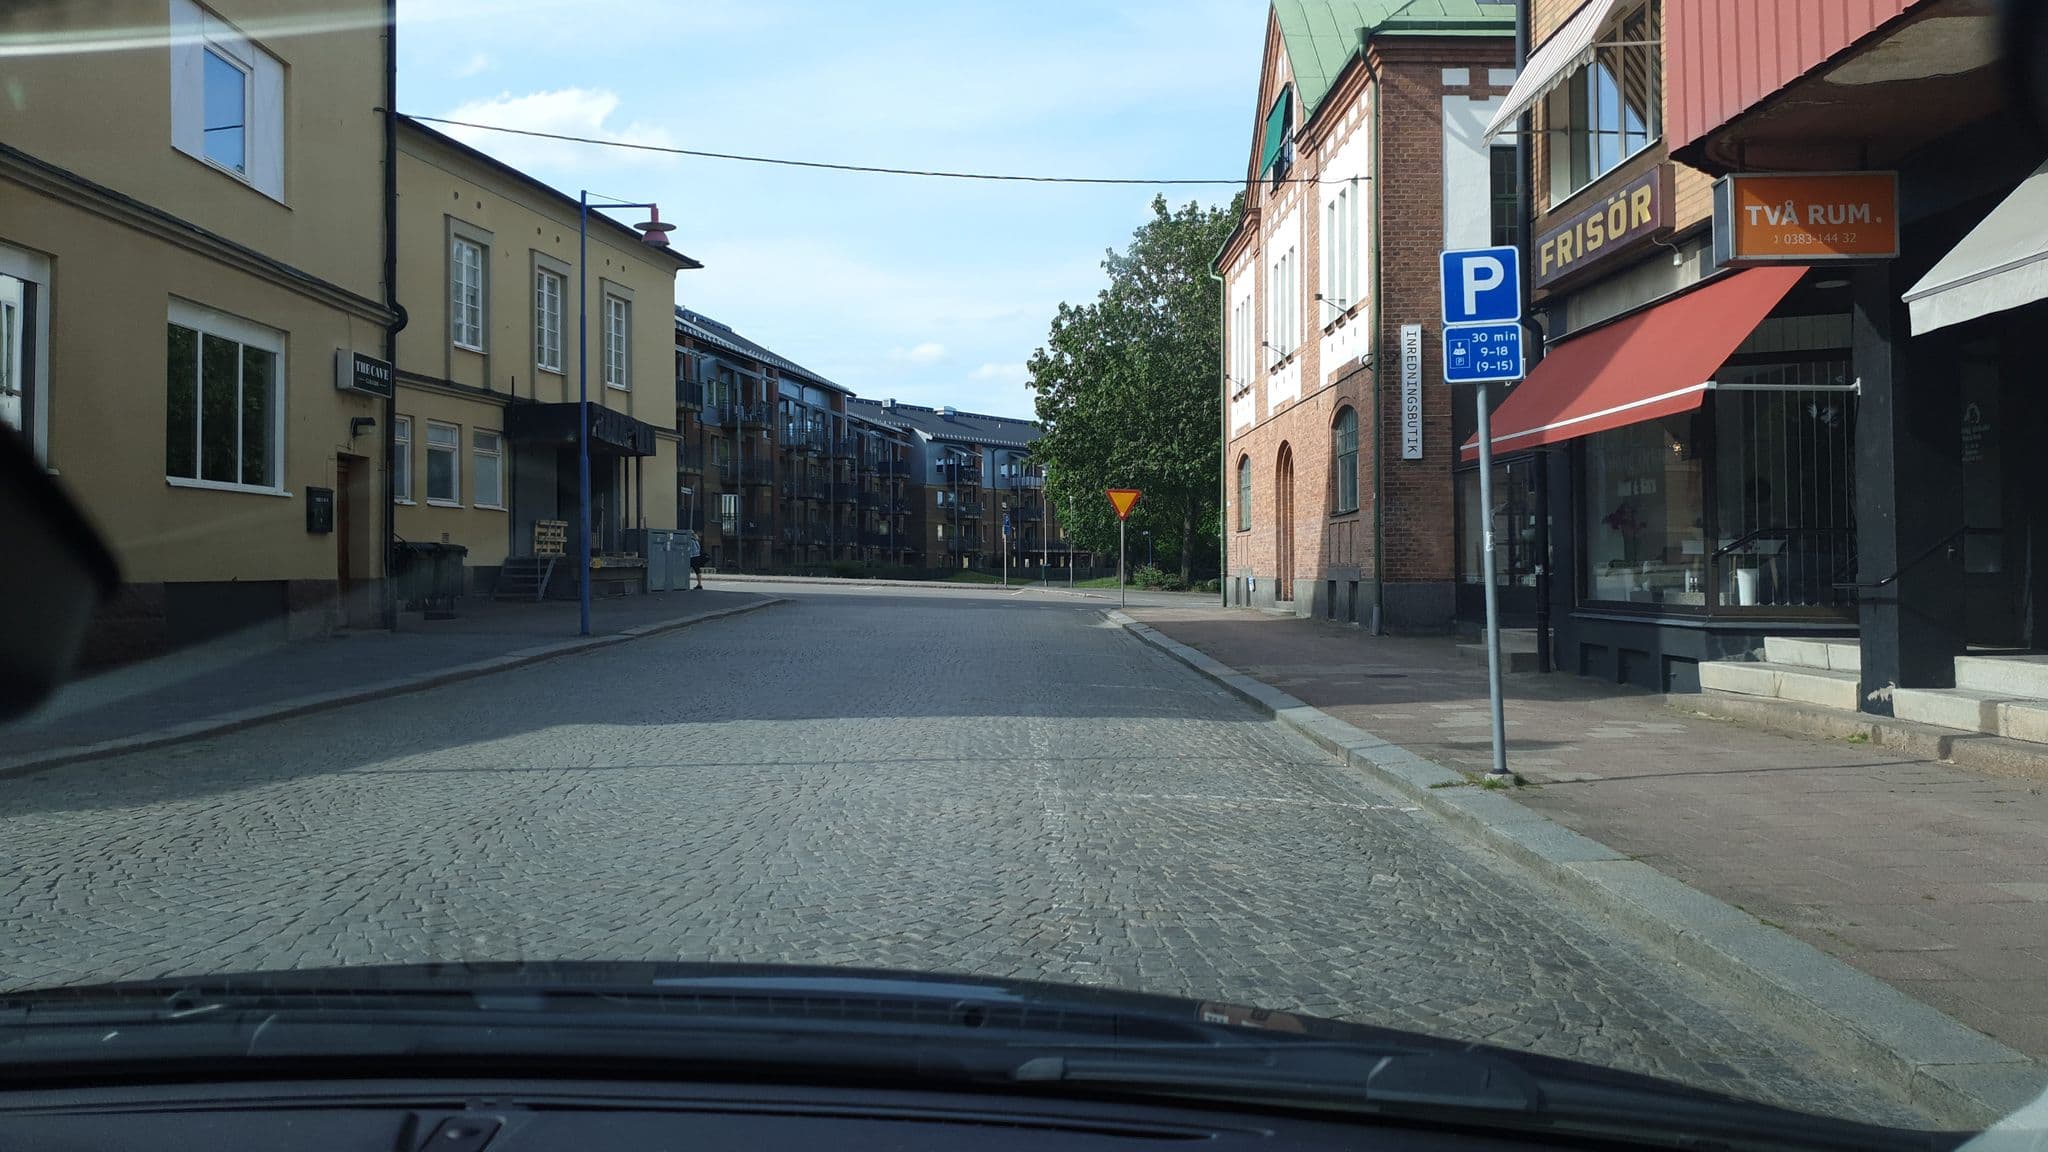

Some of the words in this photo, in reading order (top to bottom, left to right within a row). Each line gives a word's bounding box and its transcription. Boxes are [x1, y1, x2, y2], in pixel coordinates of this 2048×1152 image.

[1744, 199, 1800, 226] TVÅ
[1541, 184, 1652, 277] FRISÖR
[1784, 232, 1838, 244] 0383-144
[1842, 232, 1857, 243] 32
[1462, 256, 1505, 315] P
[1471, 332, 1488, 343] 30
[1493, 331, 1517, 342] min
[1480, 345, 1508, 357] 9-18
[1476, 359, 1514, 372] (9-15)
[1406, 331, 1418, 453] INREDNINGSBUTIK
